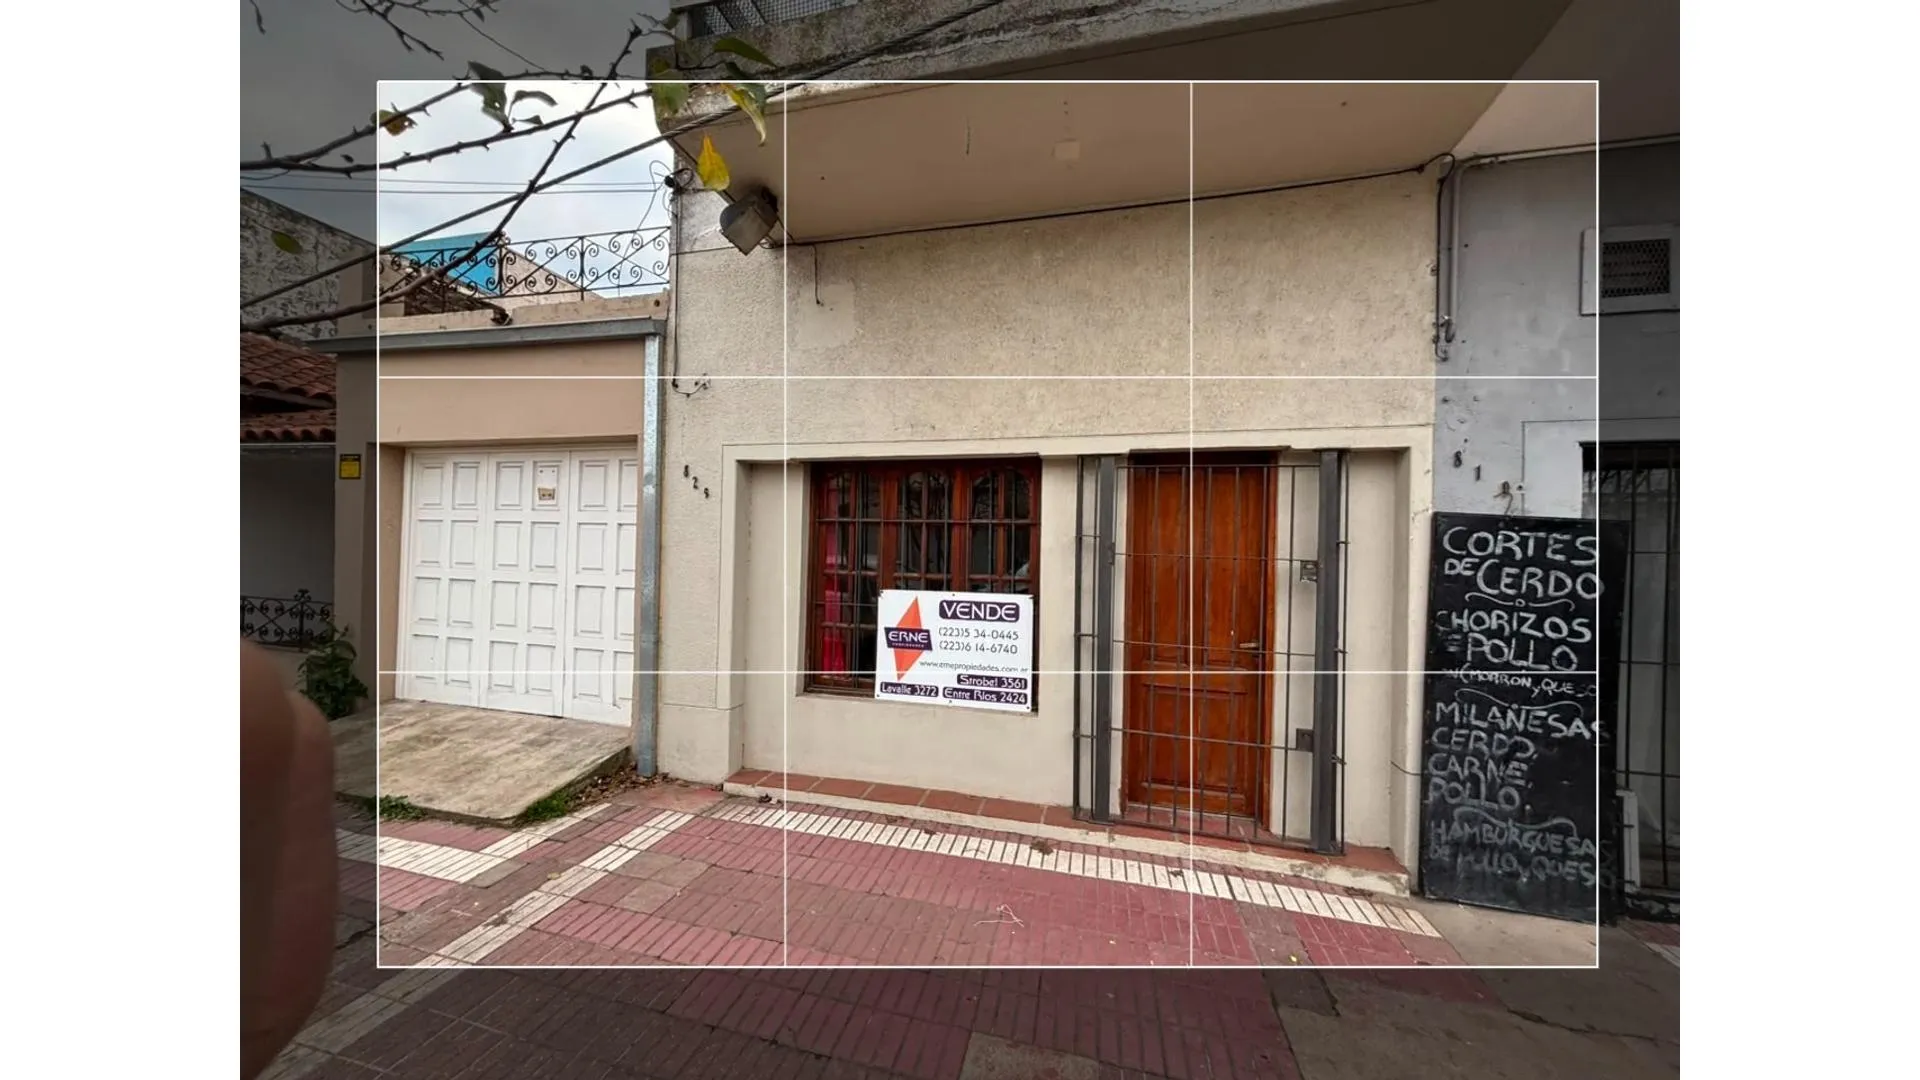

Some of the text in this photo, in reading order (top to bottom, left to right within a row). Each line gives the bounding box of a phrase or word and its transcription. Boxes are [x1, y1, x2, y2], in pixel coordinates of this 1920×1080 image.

[1442, 526, 1600, 566] CORTES
[1444, 558, 1605, 600] DE CERDO
[942, 602, 1017, 621] VENDE
[1436, 608, 1593, 643] CHORIZOS
[888, 631, 929, 643] ERNE
[973, 629, 1019, 640] 34-0445
[975, 642, 1018, 655] 14-6740
[1467, 632, 1578, 672] POLLO
[881, 683, 937, 697] Lavalle 3272
[959, 674, 1026, 690] Strobel 3561
[944, 687, 970, 700] Entre
[1000, 692, 1026, 704] 2424
